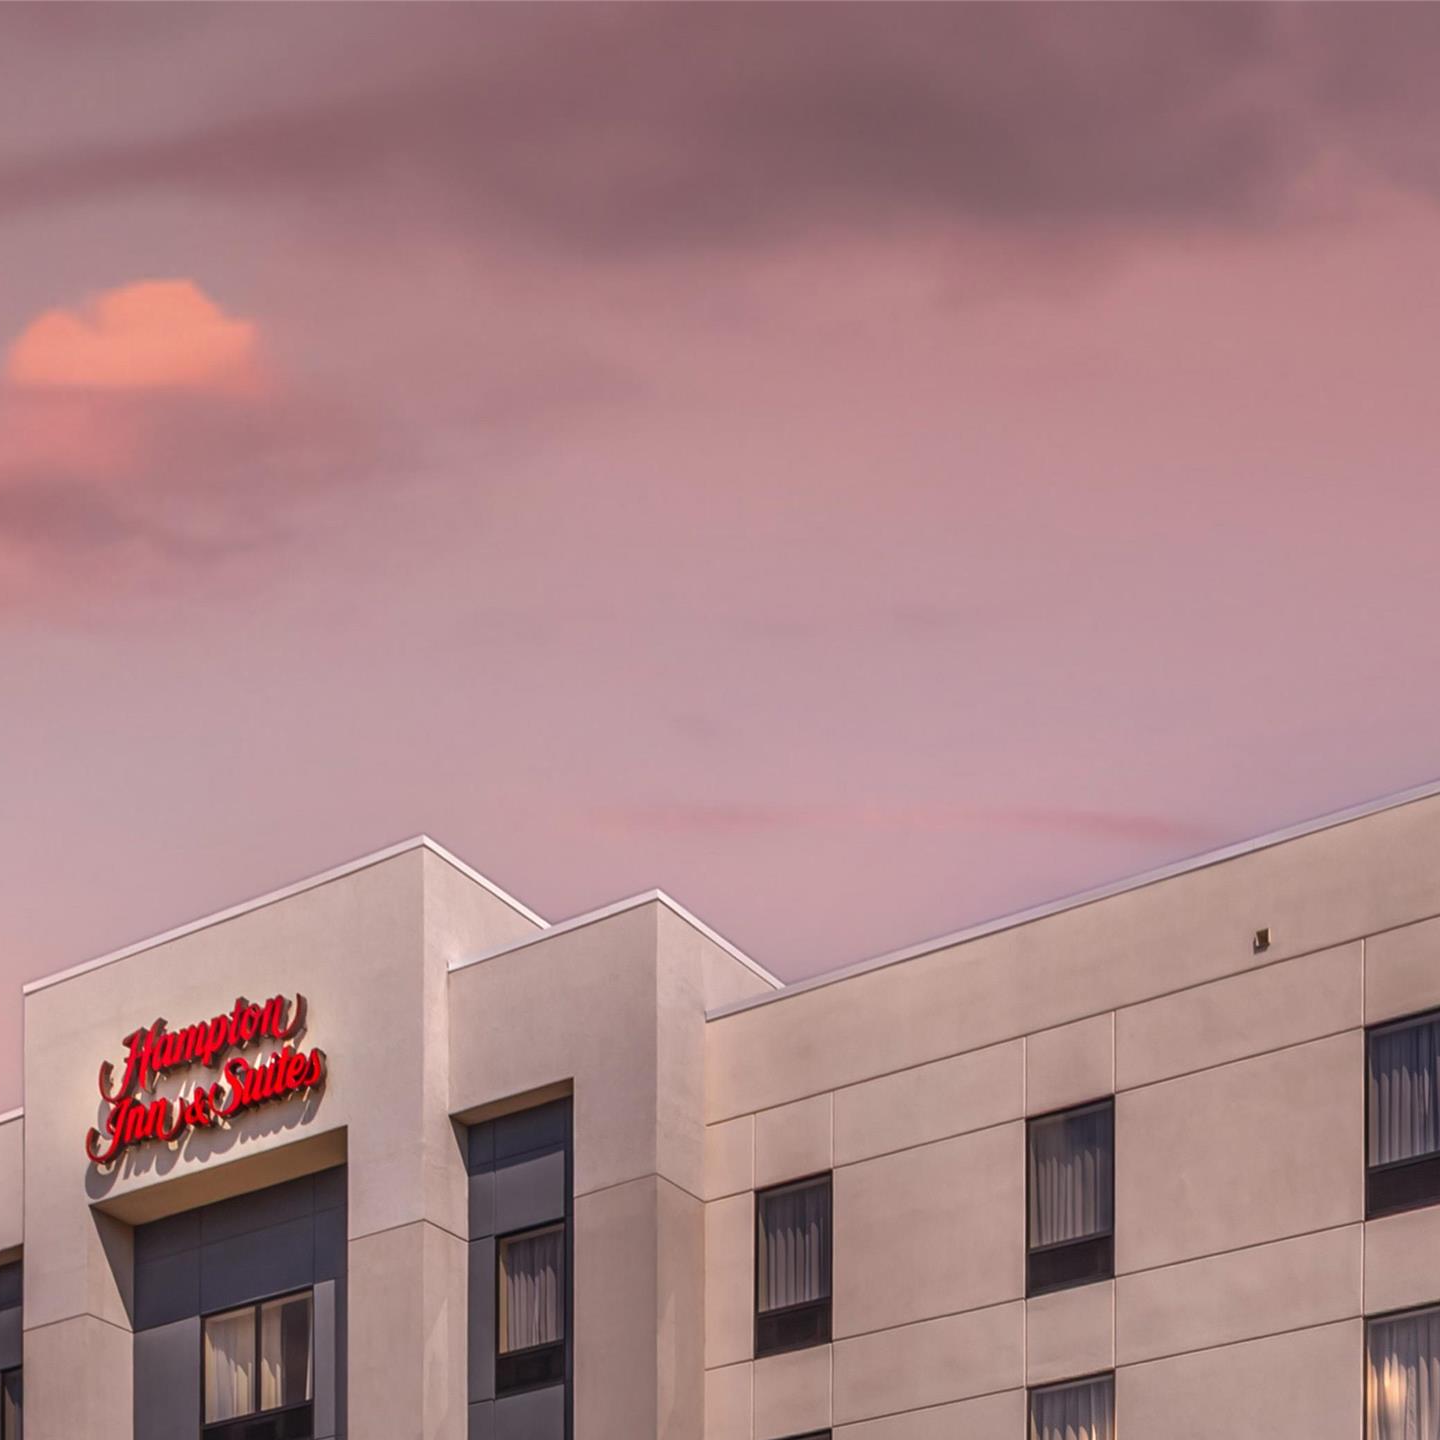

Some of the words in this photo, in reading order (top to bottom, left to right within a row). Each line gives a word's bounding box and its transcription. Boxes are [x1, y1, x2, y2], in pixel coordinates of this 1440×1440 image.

[86, 1096, 185, 1164] Inn
[185, 1087, 210, 1125] &
[209, 1046, 327, 1118] Suites
[99, 993, 307, 1104] Hampton
